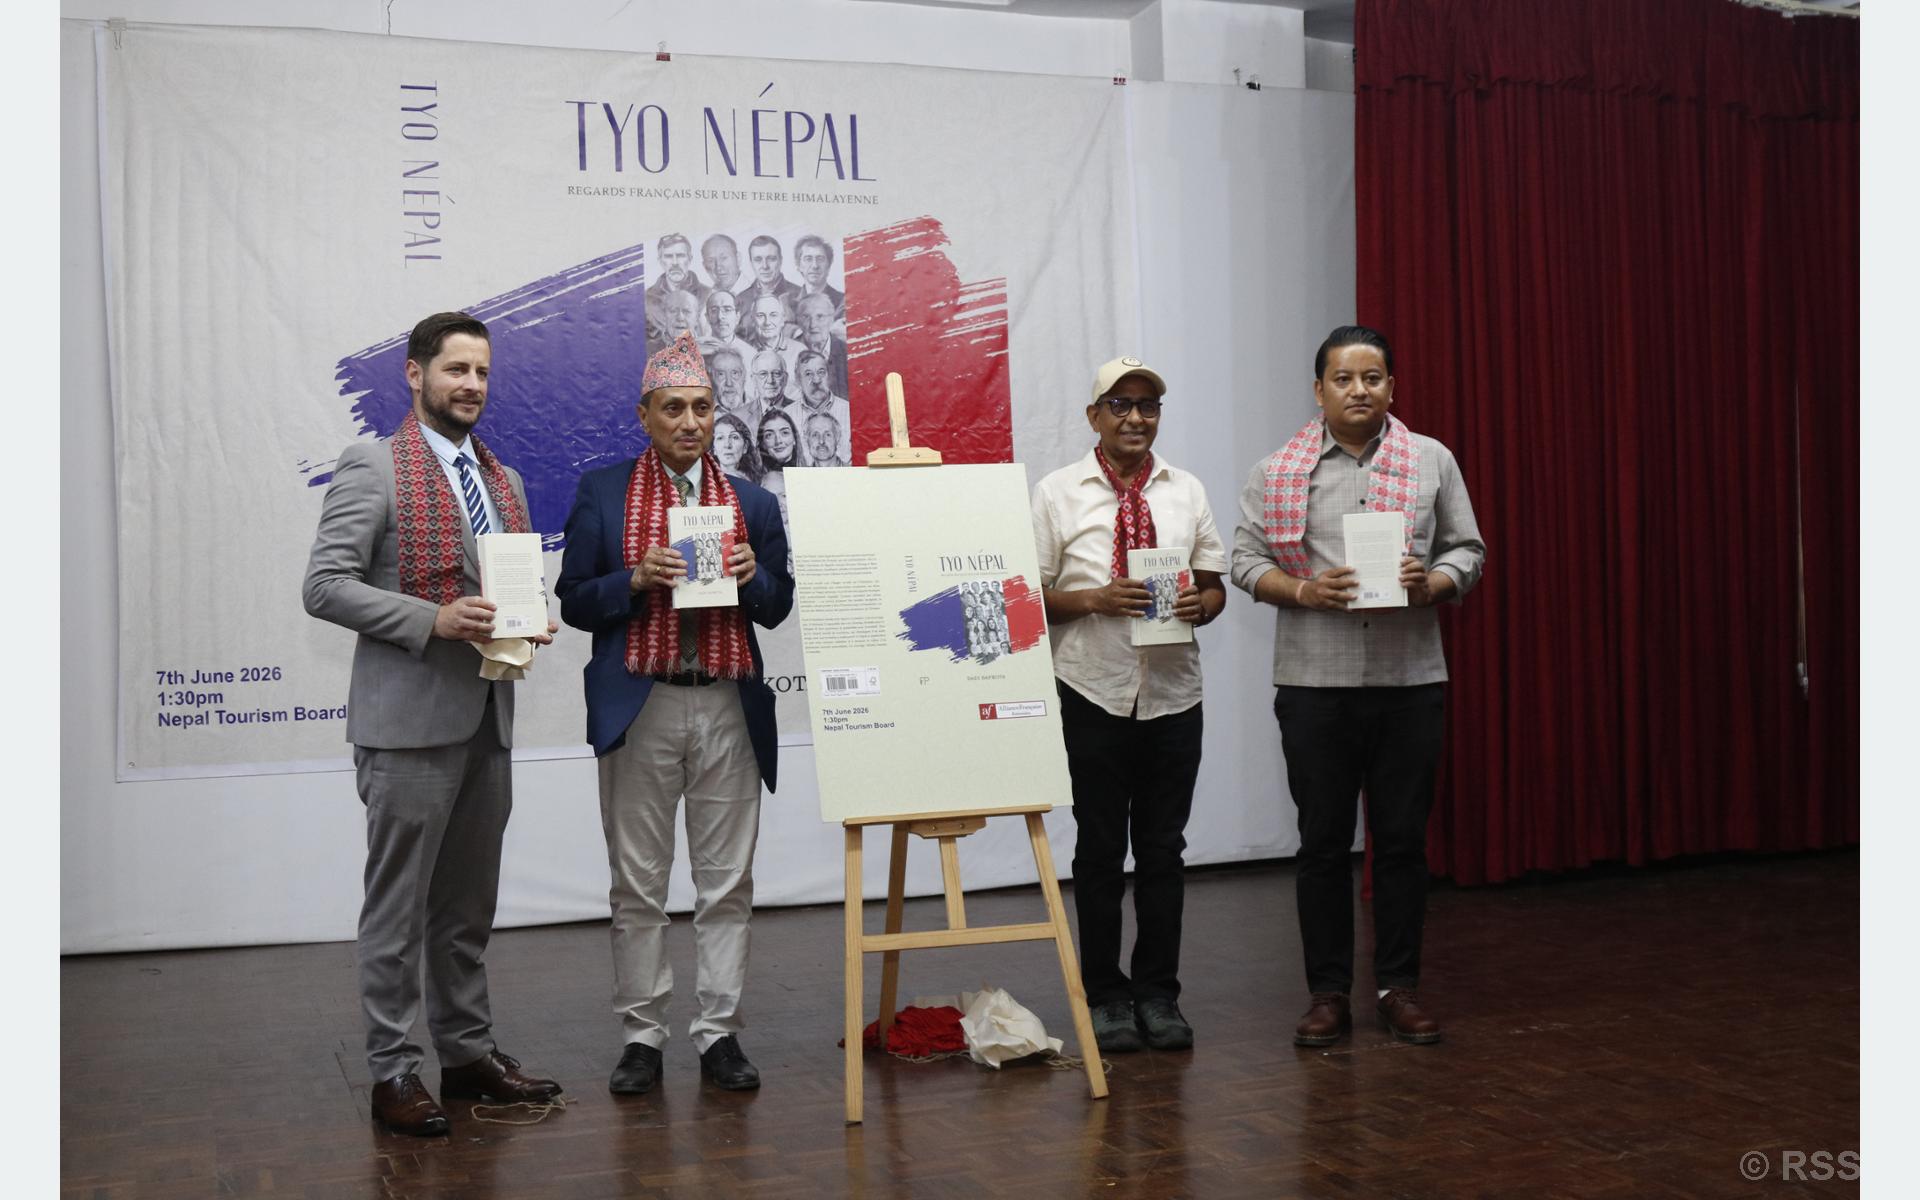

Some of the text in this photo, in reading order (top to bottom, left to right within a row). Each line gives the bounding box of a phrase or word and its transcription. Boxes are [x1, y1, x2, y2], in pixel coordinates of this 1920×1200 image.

[565, 82, 877, 182] TYO NÉPAL
[400, 80, 456, 269] TYO NÉPAL
[567, 185, 879, 205] REGARDS FRANÇAIS SUR UNE TERRE HIMALAYENNE
[938, 549, 1008, 572] TYO NÉPAL
[156, 667, 282, 685] 7th June 2026
[157, 691, 224, 708] 1:30pm
[158, 705, 347, 729] Nepal Tourism Board
[822, 707, 870, 716] 7th June 2026
[823, 716, 848, 724] 1:30pm
[824, 721, 895, 732] Nepal Tourism Board
